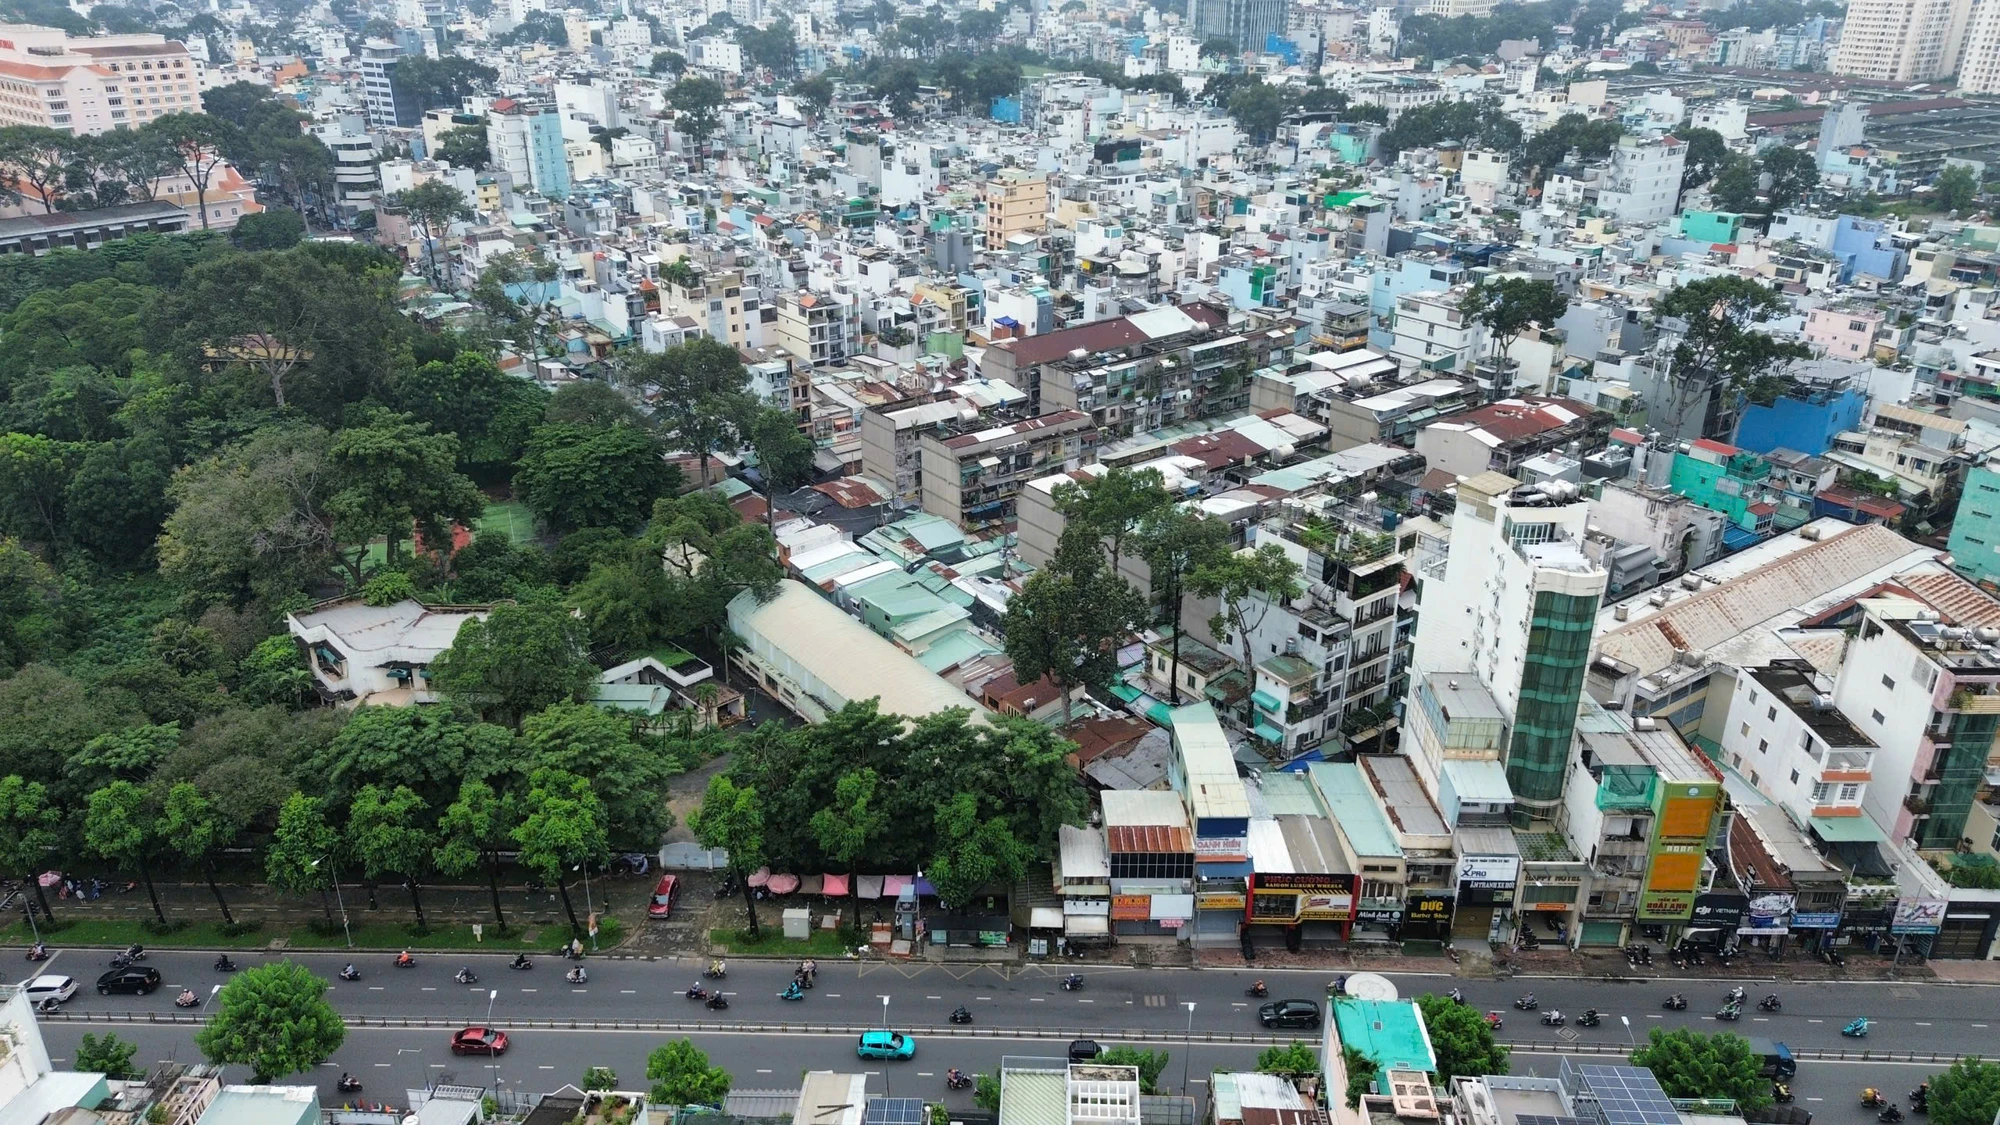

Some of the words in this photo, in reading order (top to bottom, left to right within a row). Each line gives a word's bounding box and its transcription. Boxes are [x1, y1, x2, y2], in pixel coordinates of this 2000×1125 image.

[1264, 874, 1293, 883] PHÚC
[1420, 900, 1443, 911] ĐỨC
[1376, 911, 1389, 919] Anh
